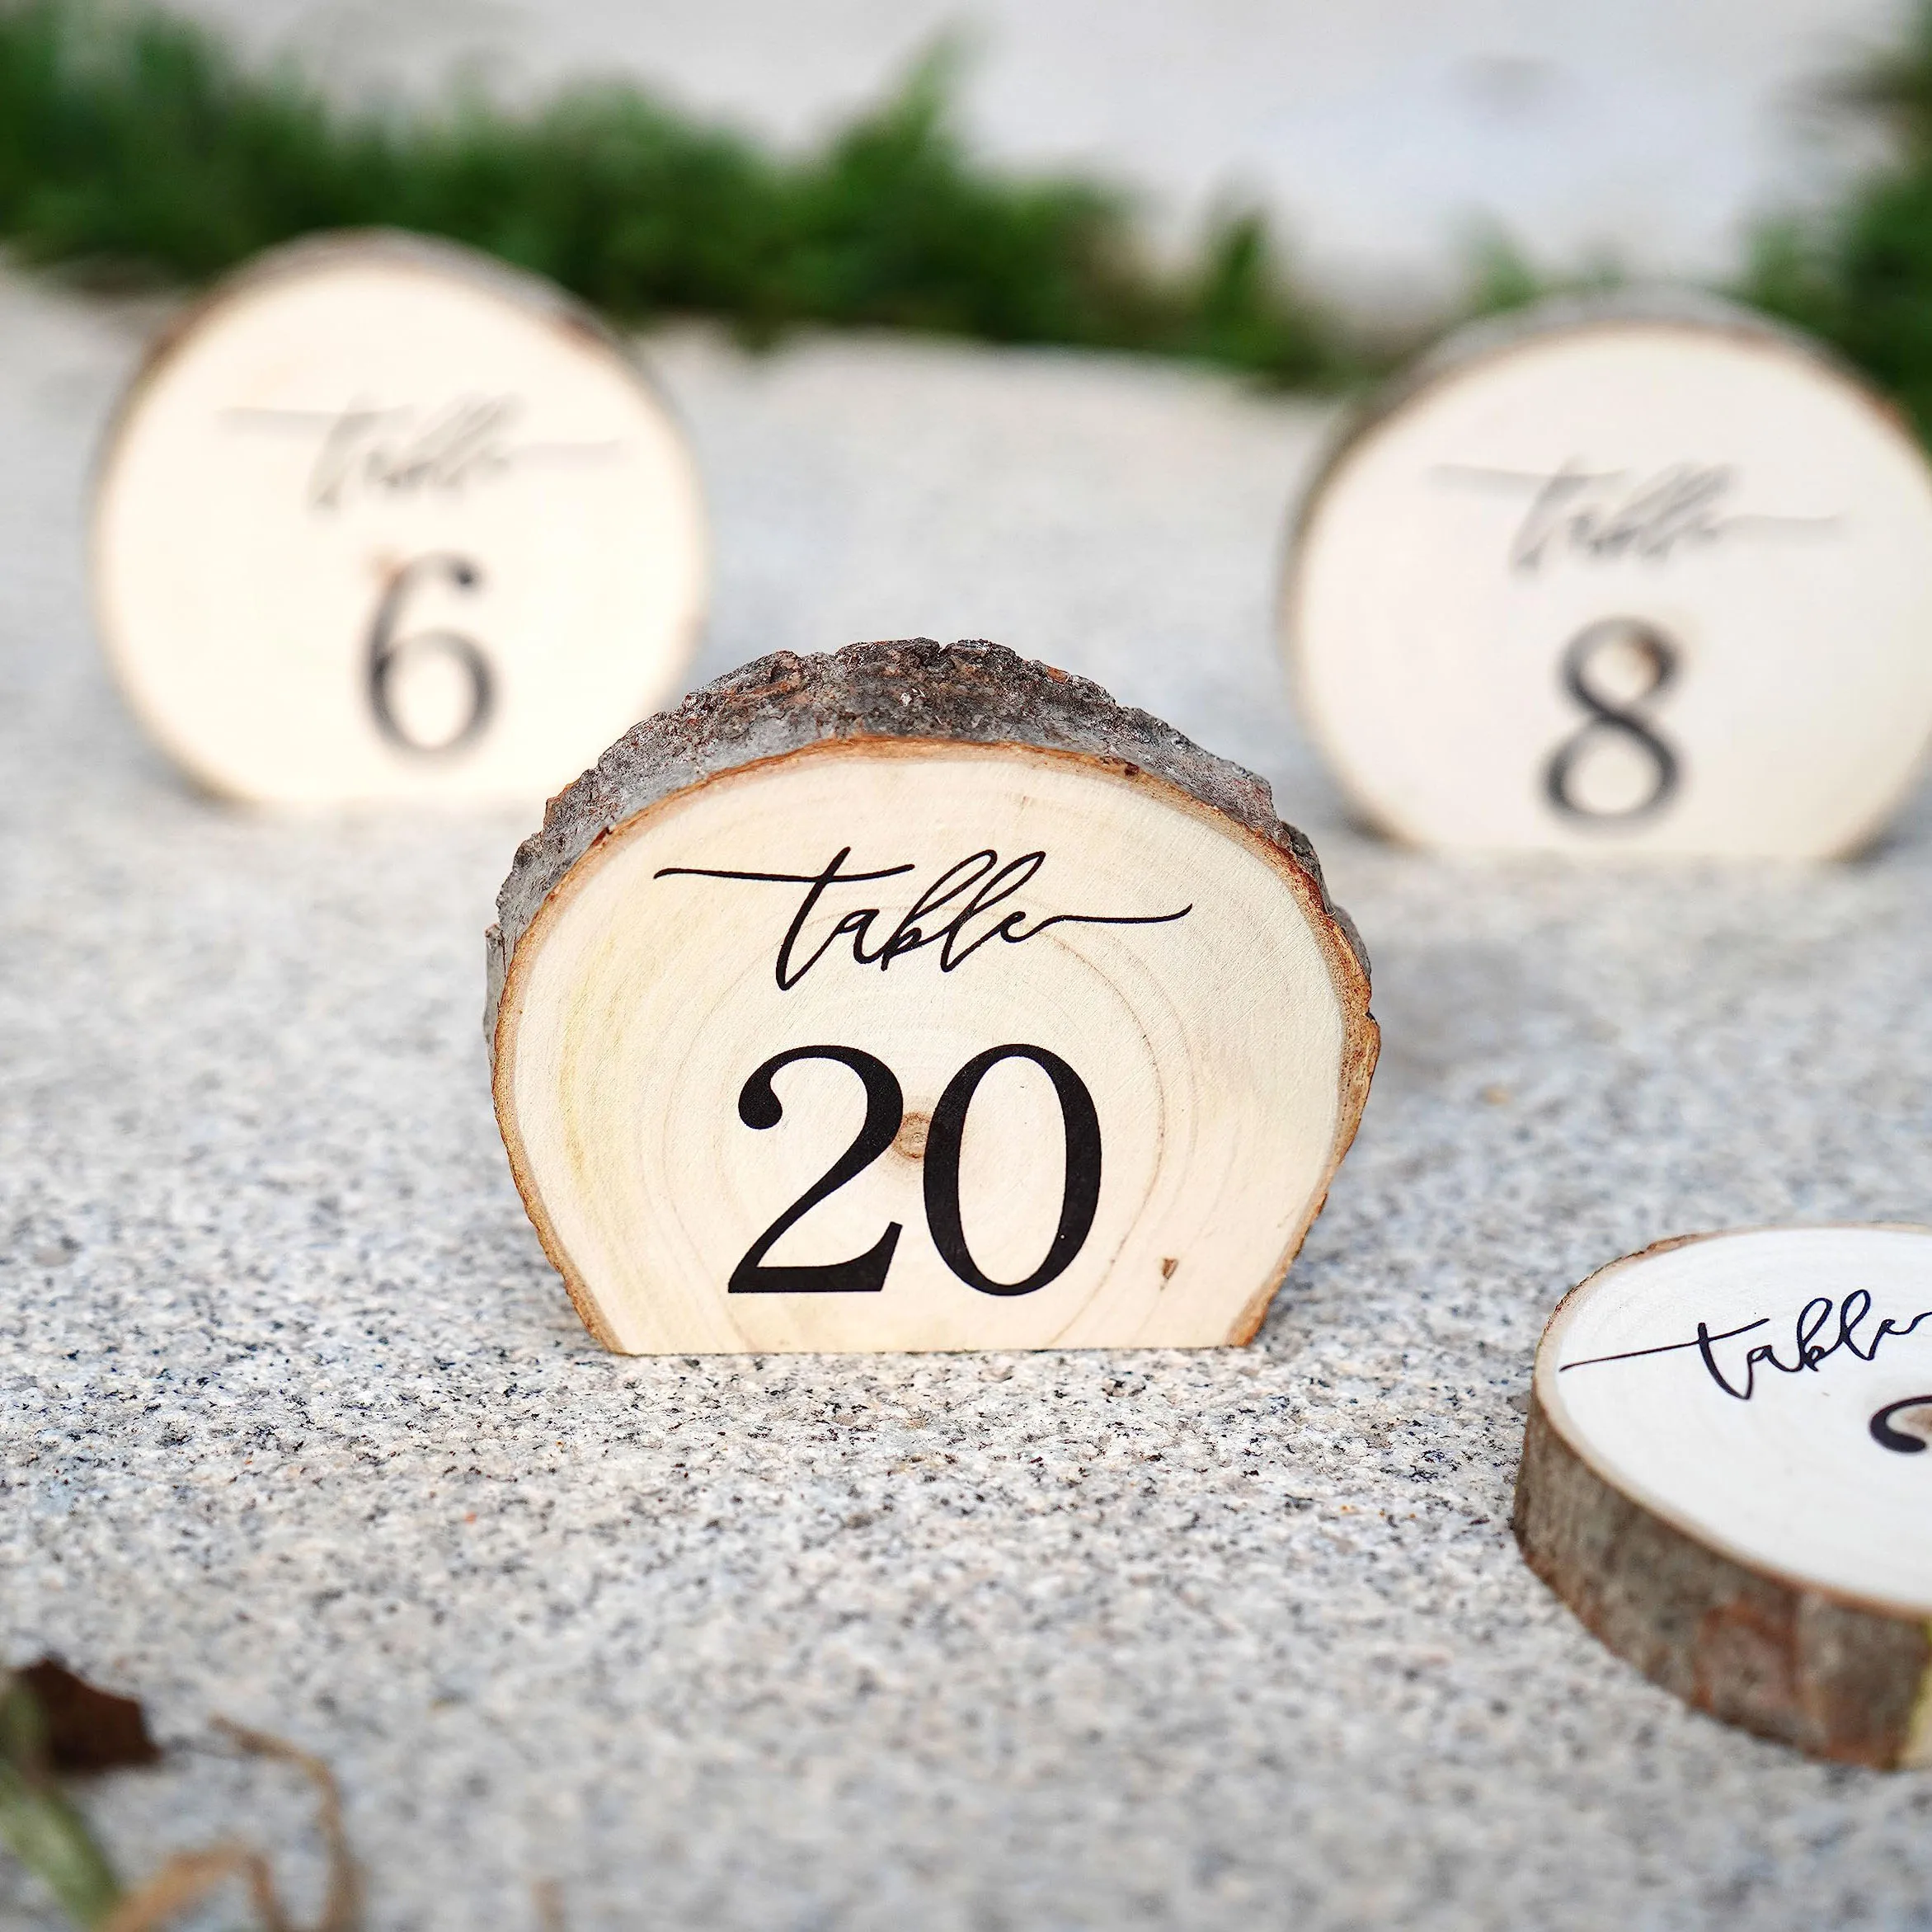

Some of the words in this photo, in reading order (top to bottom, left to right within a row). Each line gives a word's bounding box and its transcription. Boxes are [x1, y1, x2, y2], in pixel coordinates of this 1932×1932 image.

[361, 551, 503, 763] 6
[1538, 618, 1686, 833] 8
[654, 846, 1193, 991] table
[728, 1043, 1102, 1296] 20
[1558, 1289, 1932, 1400] table
